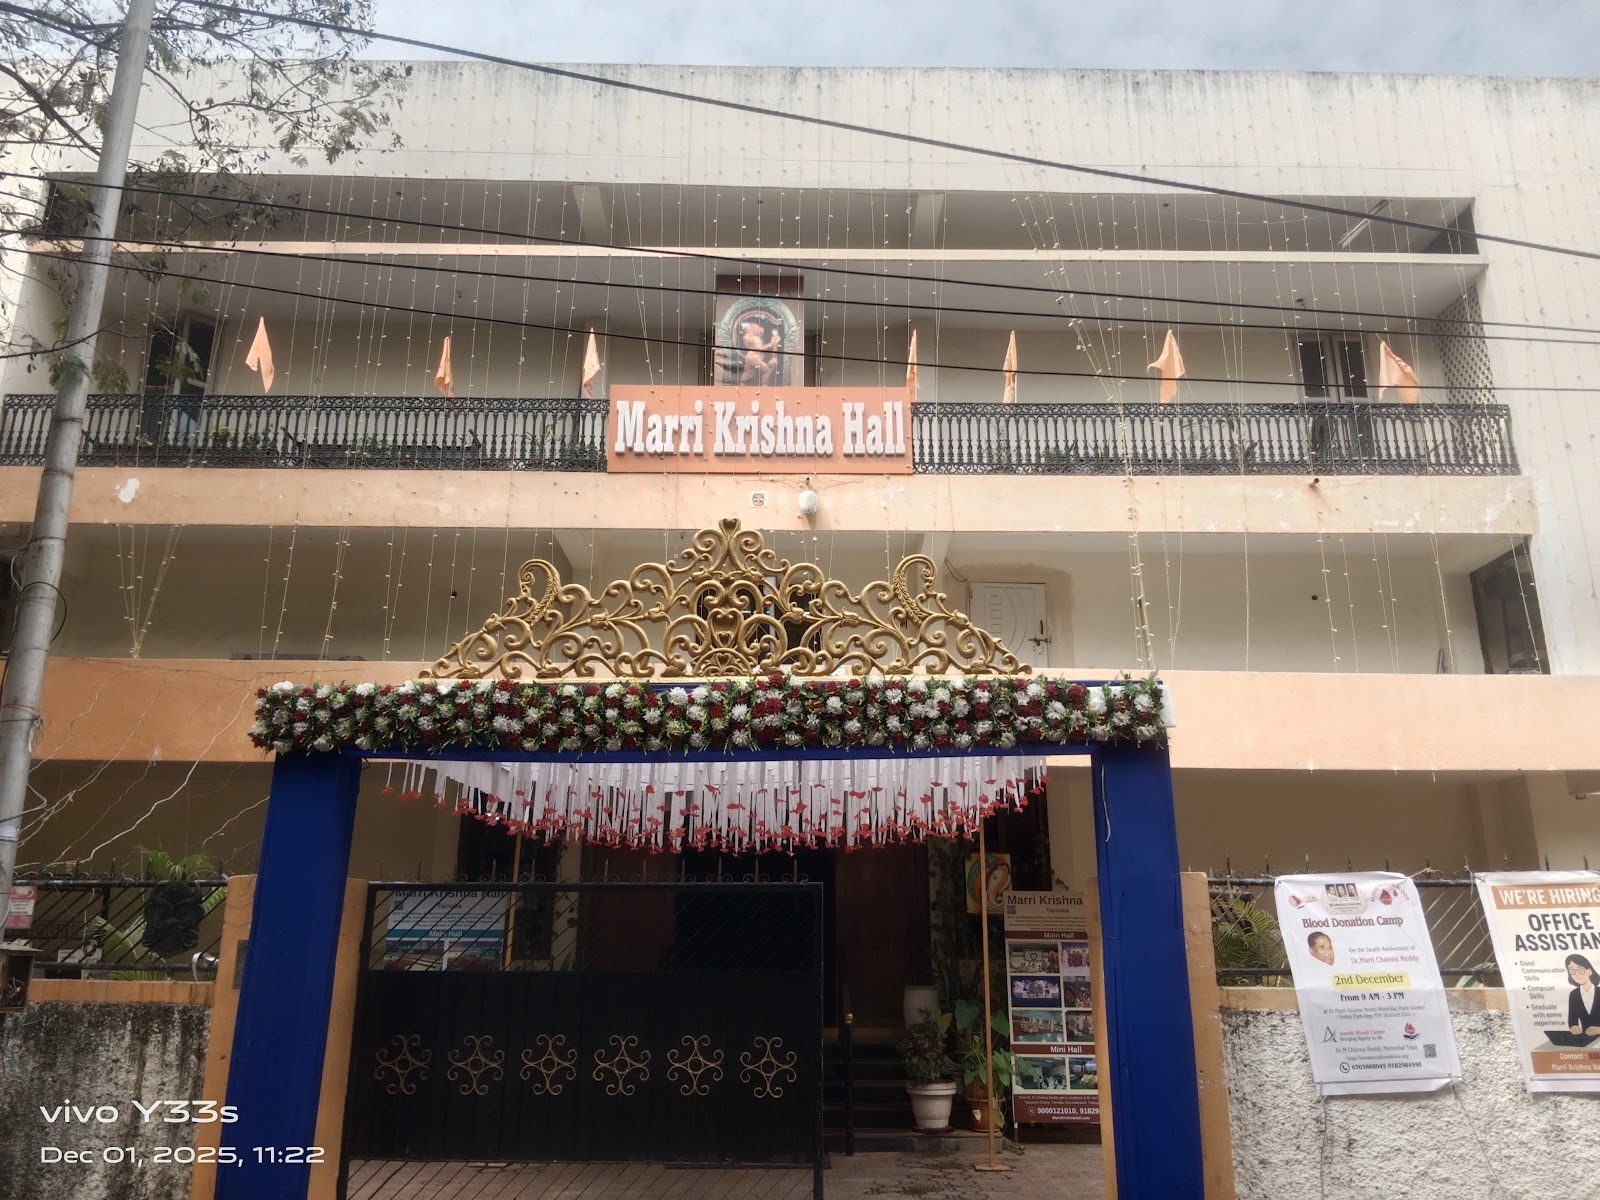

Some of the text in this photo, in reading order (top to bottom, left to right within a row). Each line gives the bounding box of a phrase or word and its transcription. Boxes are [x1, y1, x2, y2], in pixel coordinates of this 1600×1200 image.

[614, 400, 906, 457] Marri Krishna Hall
[1007, 895, 1083, 905] Marri Krishna
[1500, 887, 1600, 906] WE'RE HIRING
[1302, 916, 1404, 928] Blood Donation Camp
[1528, 912, 1594, 932] OFFICE
[1335, 974, 1404, 985] 2nd December
